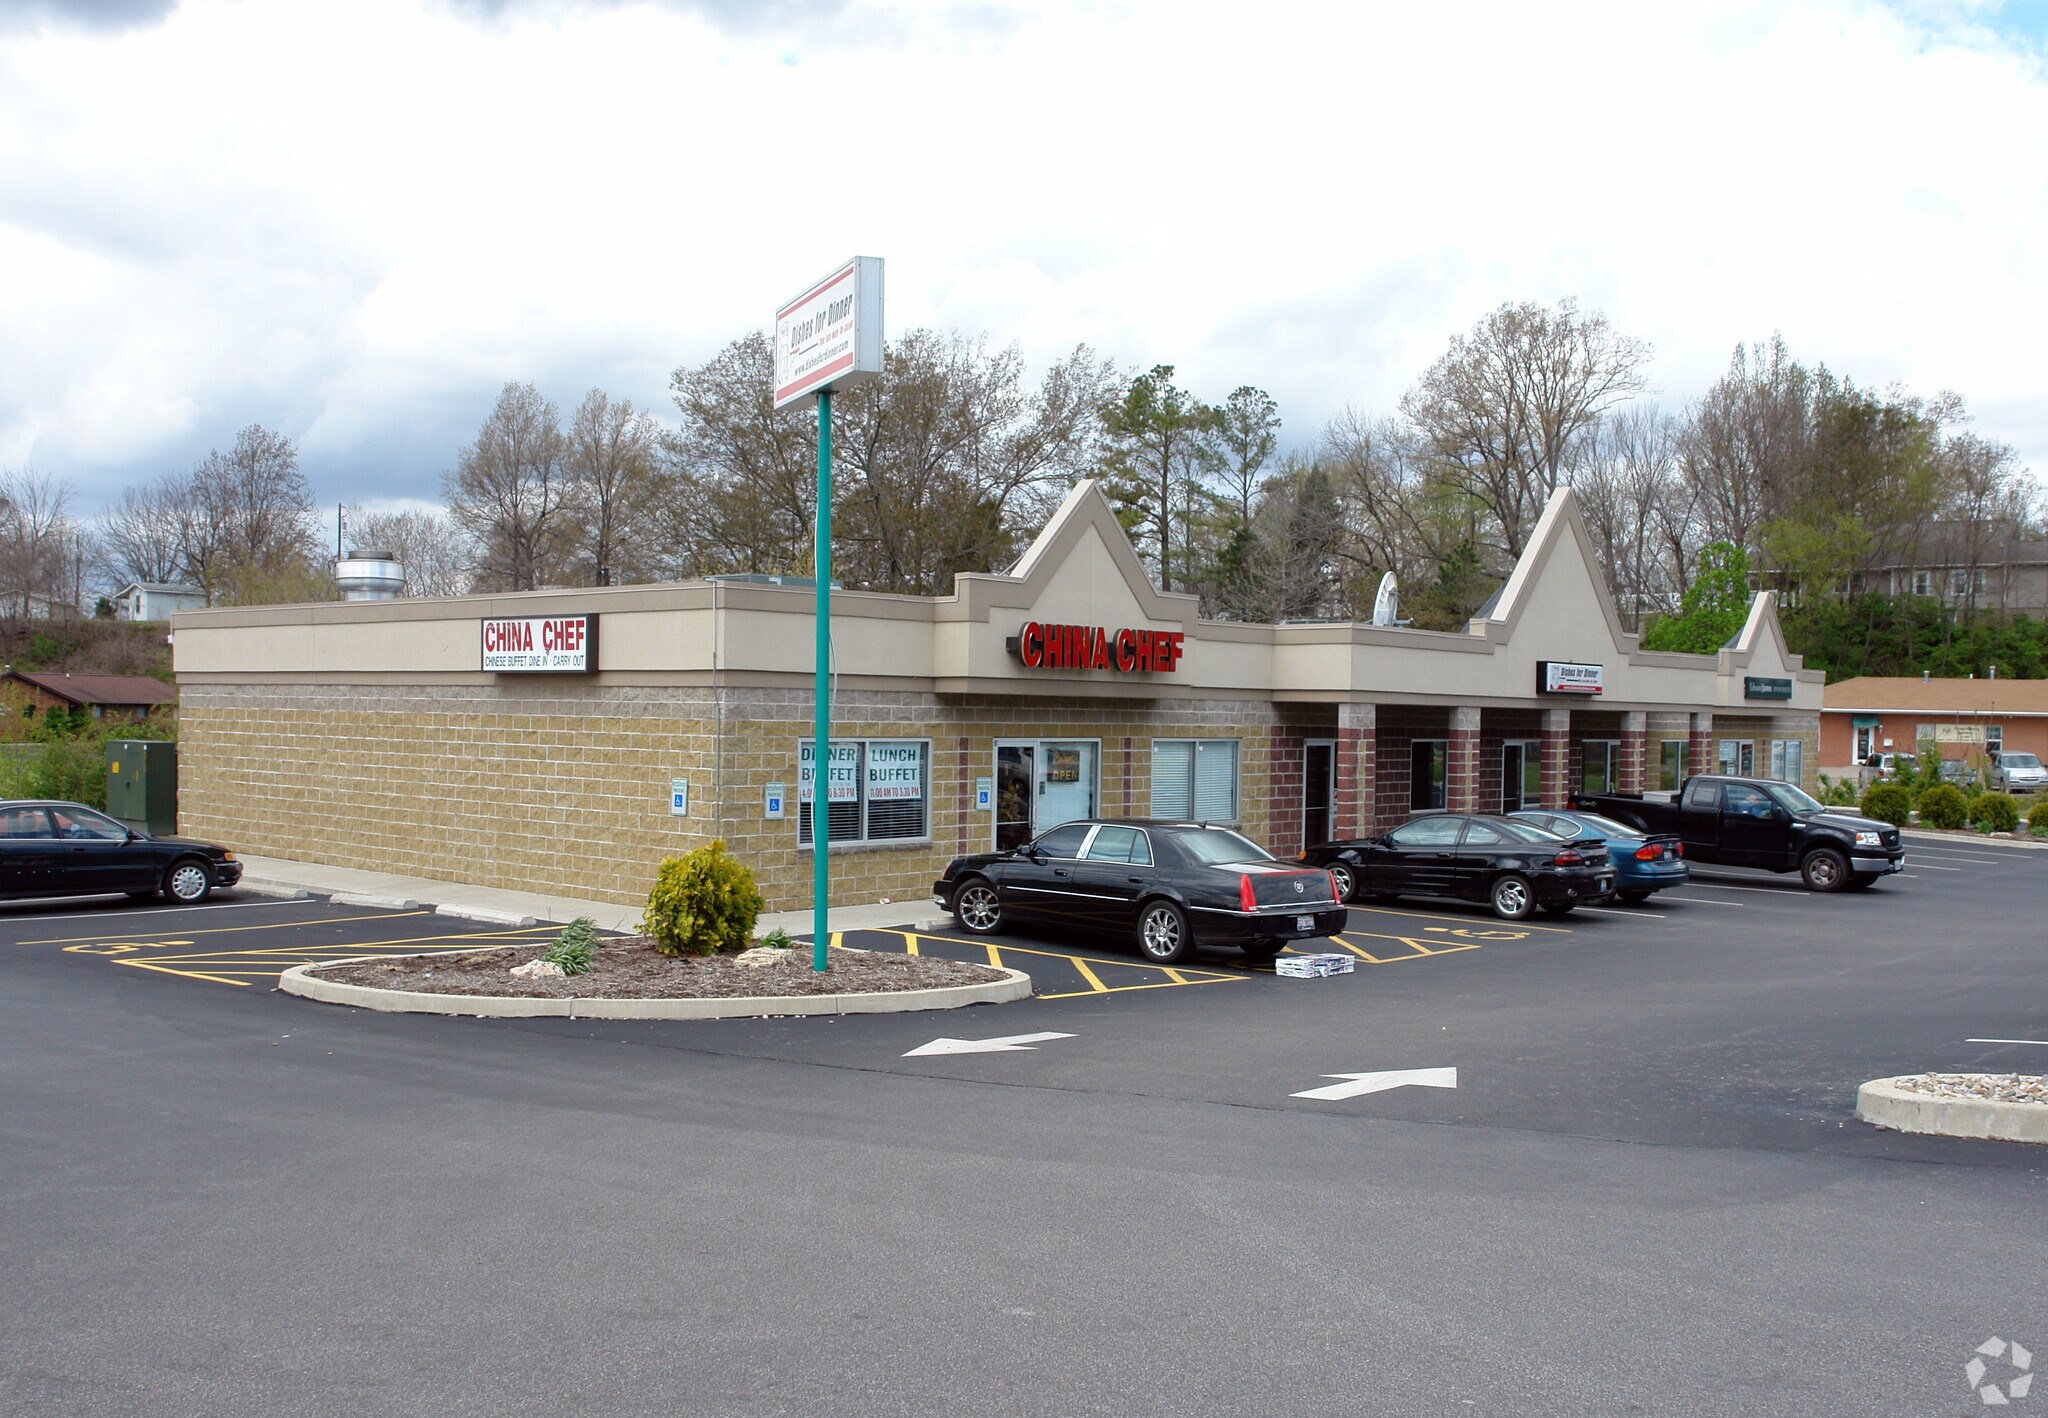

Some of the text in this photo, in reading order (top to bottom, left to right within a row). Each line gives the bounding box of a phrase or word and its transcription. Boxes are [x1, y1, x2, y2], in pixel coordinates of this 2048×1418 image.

[791, 318, 814, 349] Dishes
[815, 311, 827, 335] for
[828, 293, 853, 327] Dinner
[485, 620, 585, 652] CHINA CHEF
[1022, 621, 1184, 672] CHINA CHEF
[485, 655, 584, 667] CHINESE BUFFET DINE IN CARRY OUT
[801, 748, 855, 761] DINER
[872, 749, 916, 762] LUNCH
[870, 768, 917, 781] BUFFET
[1053, 770, 1077, 780] OPEN
[883, 787, 891, 797] AM
[892, 787, 898, 797] TO
[911, 786, 919, 797] PM
